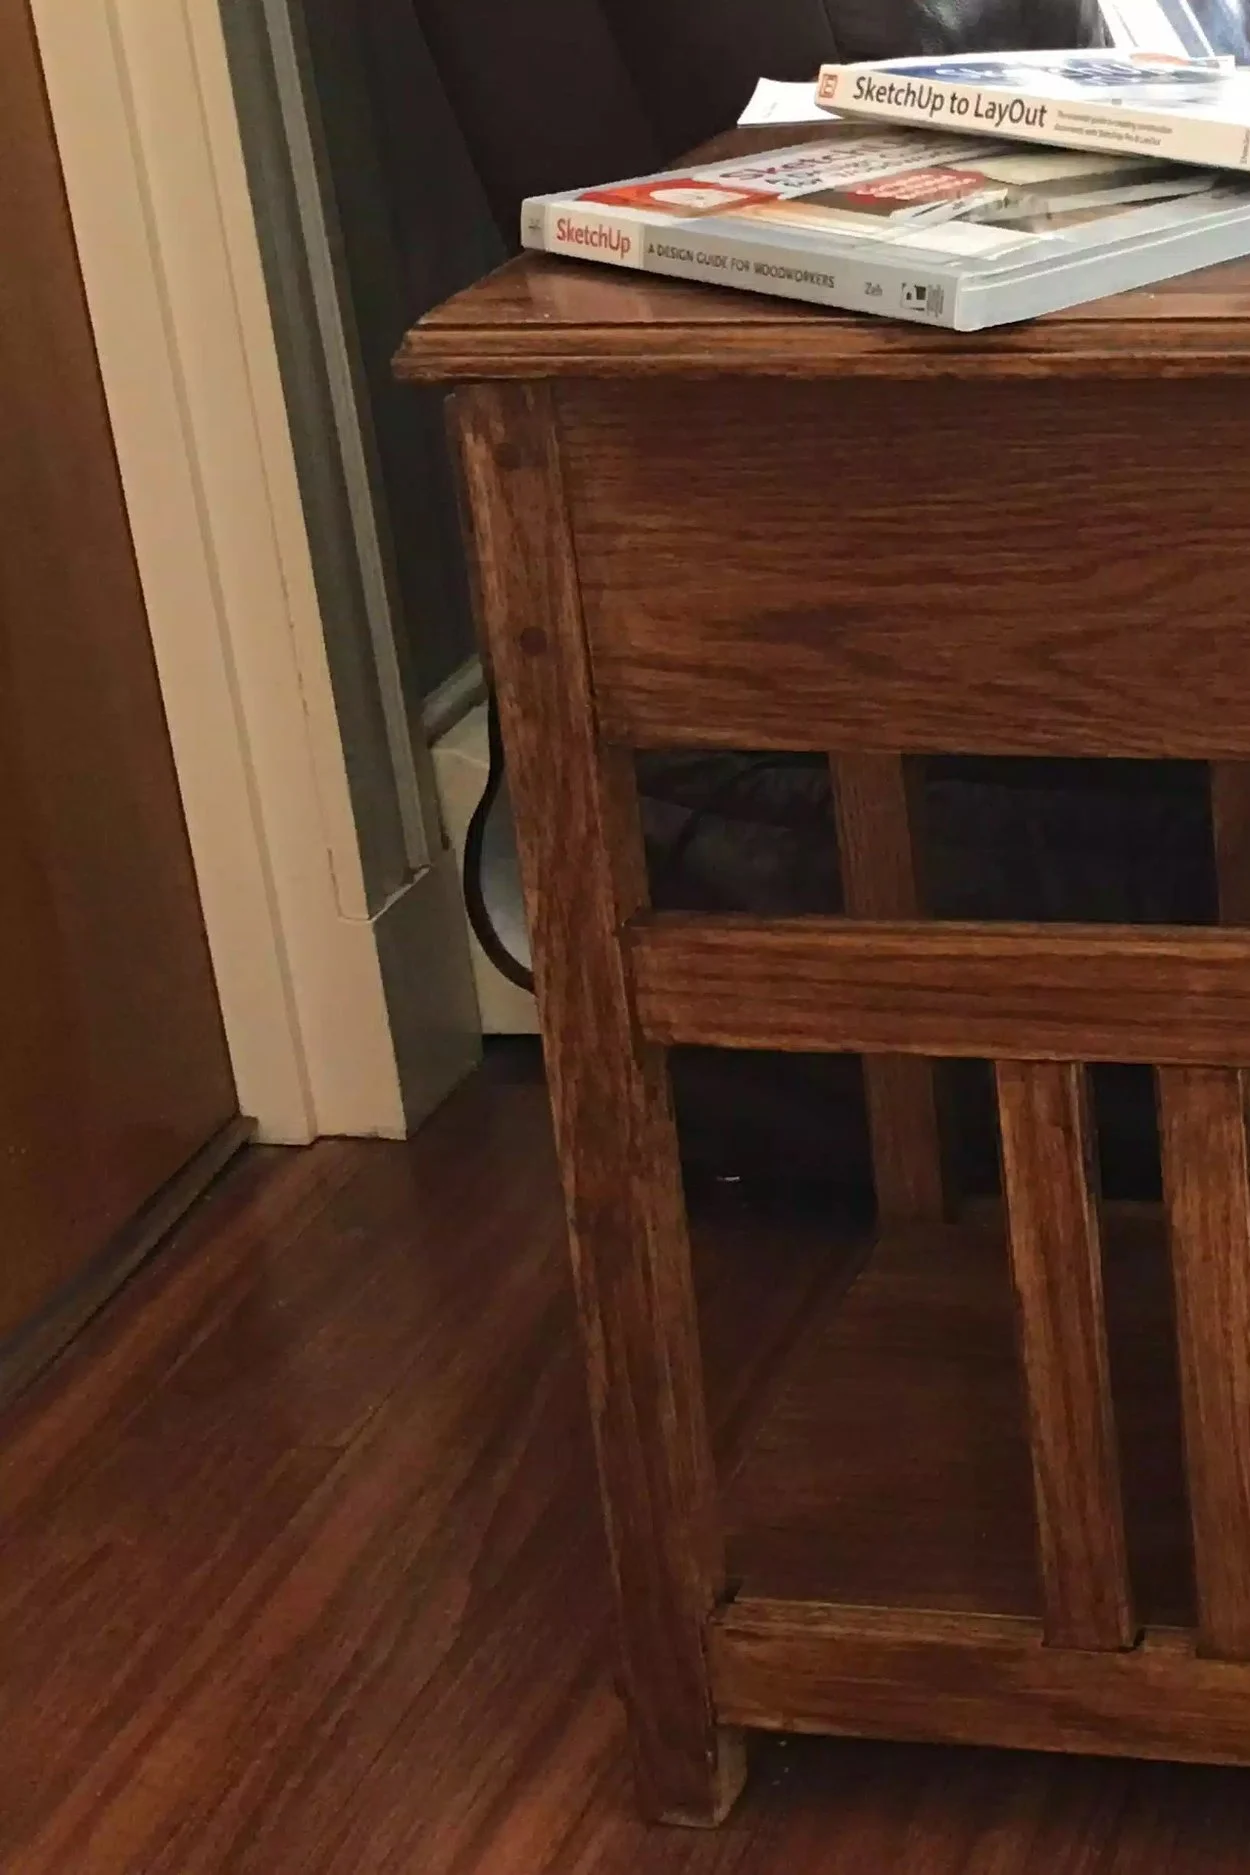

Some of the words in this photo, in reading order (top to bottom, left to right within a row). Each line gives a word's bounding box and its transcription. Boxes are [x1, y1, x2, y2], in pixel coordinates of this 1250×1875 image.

[853, 76, 945, 117] SketchUp
[950, 93, 970, 113] to
[974, 94, 1048, 128] LayOut
[556, 218, 632, 259] SketchUp
[648, 243, 654, 253] A
[657, 244, 694, 262] DESIGN
[696, 252, 727, 270] GUIDE
[730, 258, 750, 272] FOR
[753, 262, 835, 288] WOODWORKERS
